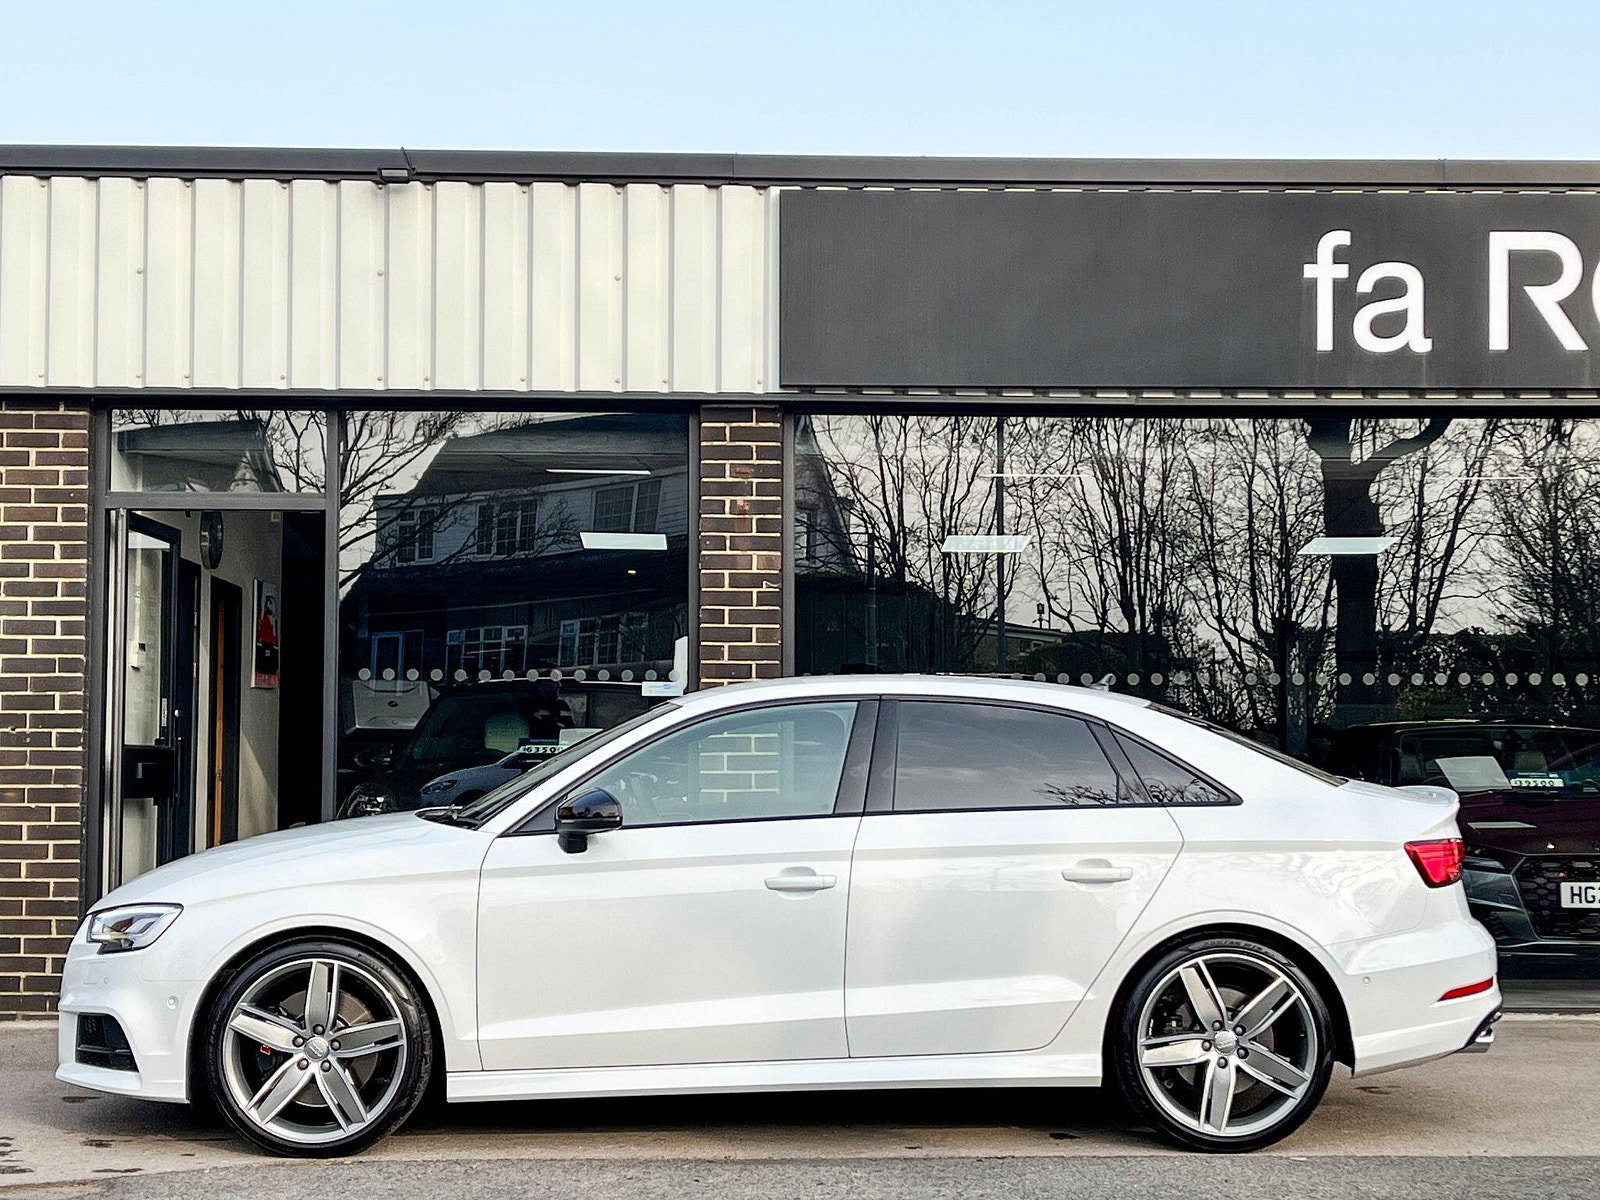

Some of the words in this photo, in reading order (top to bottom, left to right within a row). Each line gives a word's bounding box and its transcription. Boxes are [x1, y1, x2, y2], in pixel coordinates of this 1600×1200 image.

[1303, 229, 1433, 353] fa
[1489, 231, 1600, 351] R
[1570, 885, 1600, 904] HG
